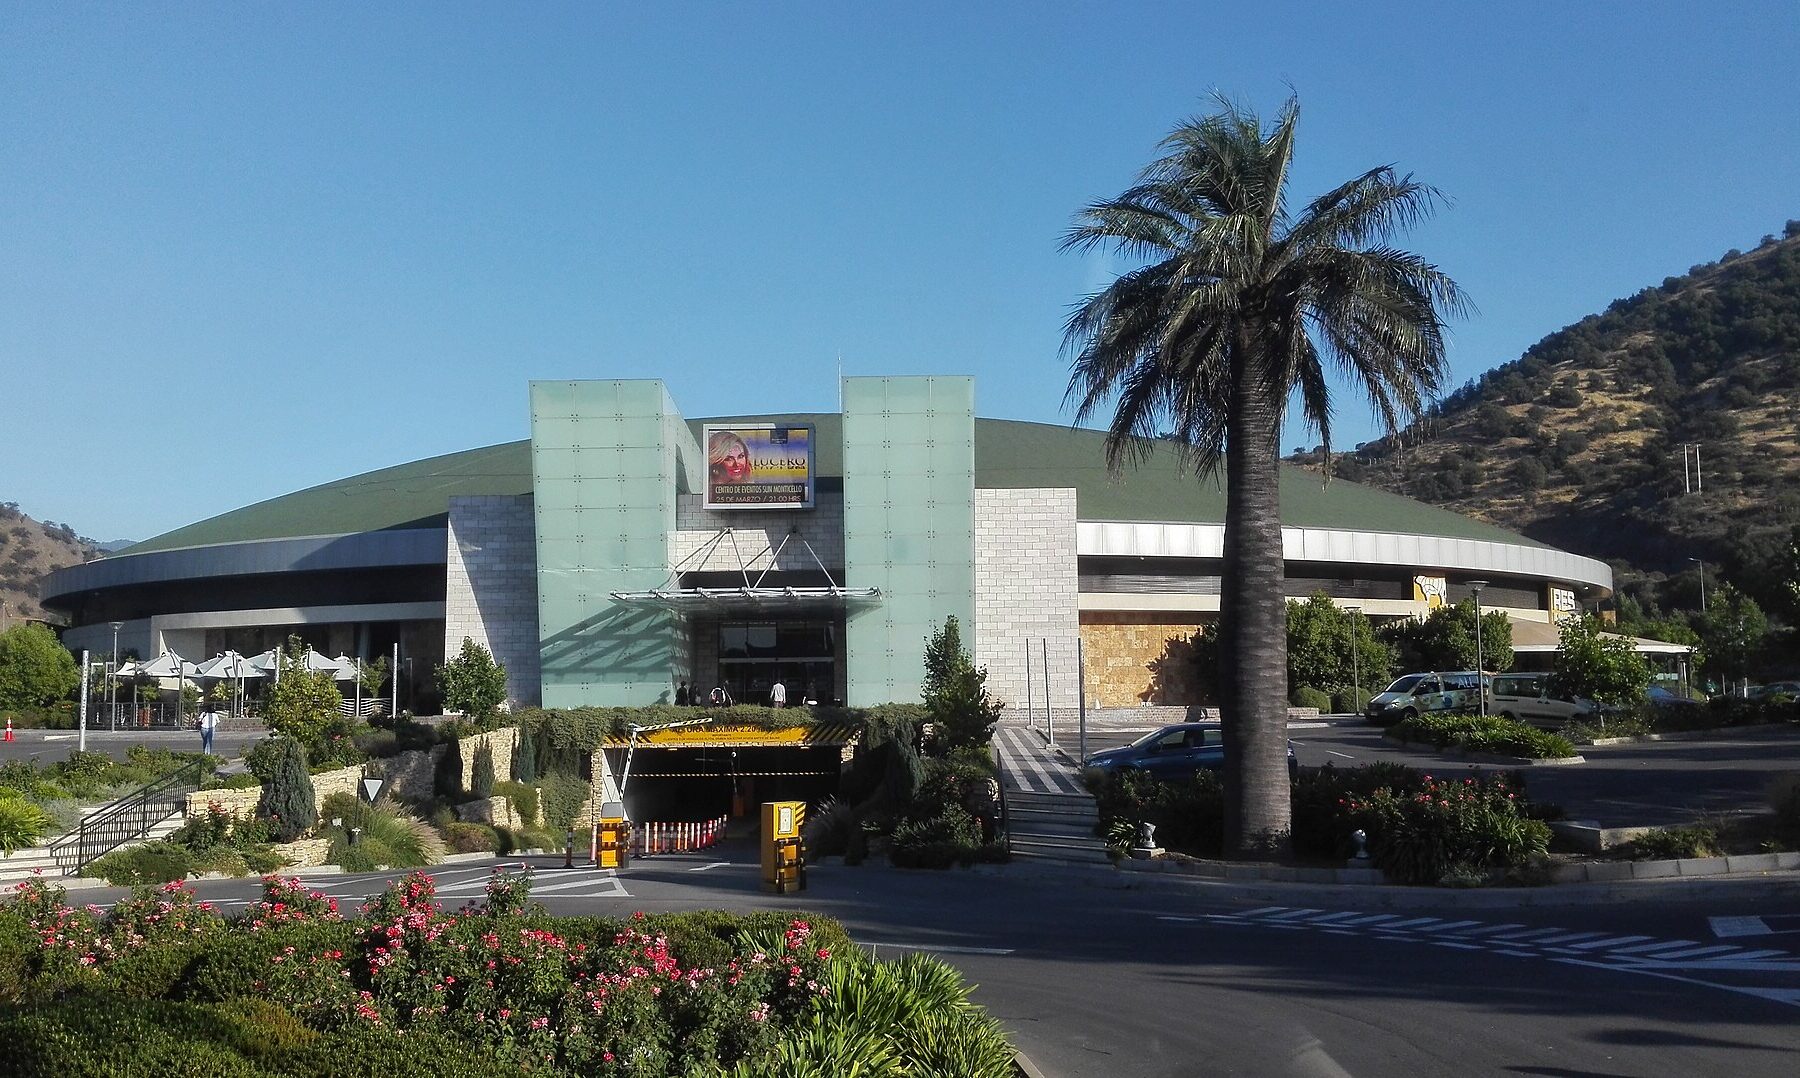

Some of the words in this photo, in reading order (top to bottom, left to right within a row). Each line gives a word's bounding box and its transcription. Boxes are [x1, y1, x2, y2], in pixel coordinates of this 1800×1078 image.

[753, 457, 806, 467] LUCERO
[715, 485, 734, 494] CENTRO
[734, 485, 741, 493] DE
[742, 485, 762, 494] EVENTOS
[762, 485, 773, 493] SUN
[773, 484, 803, 493] MONTICELLO
